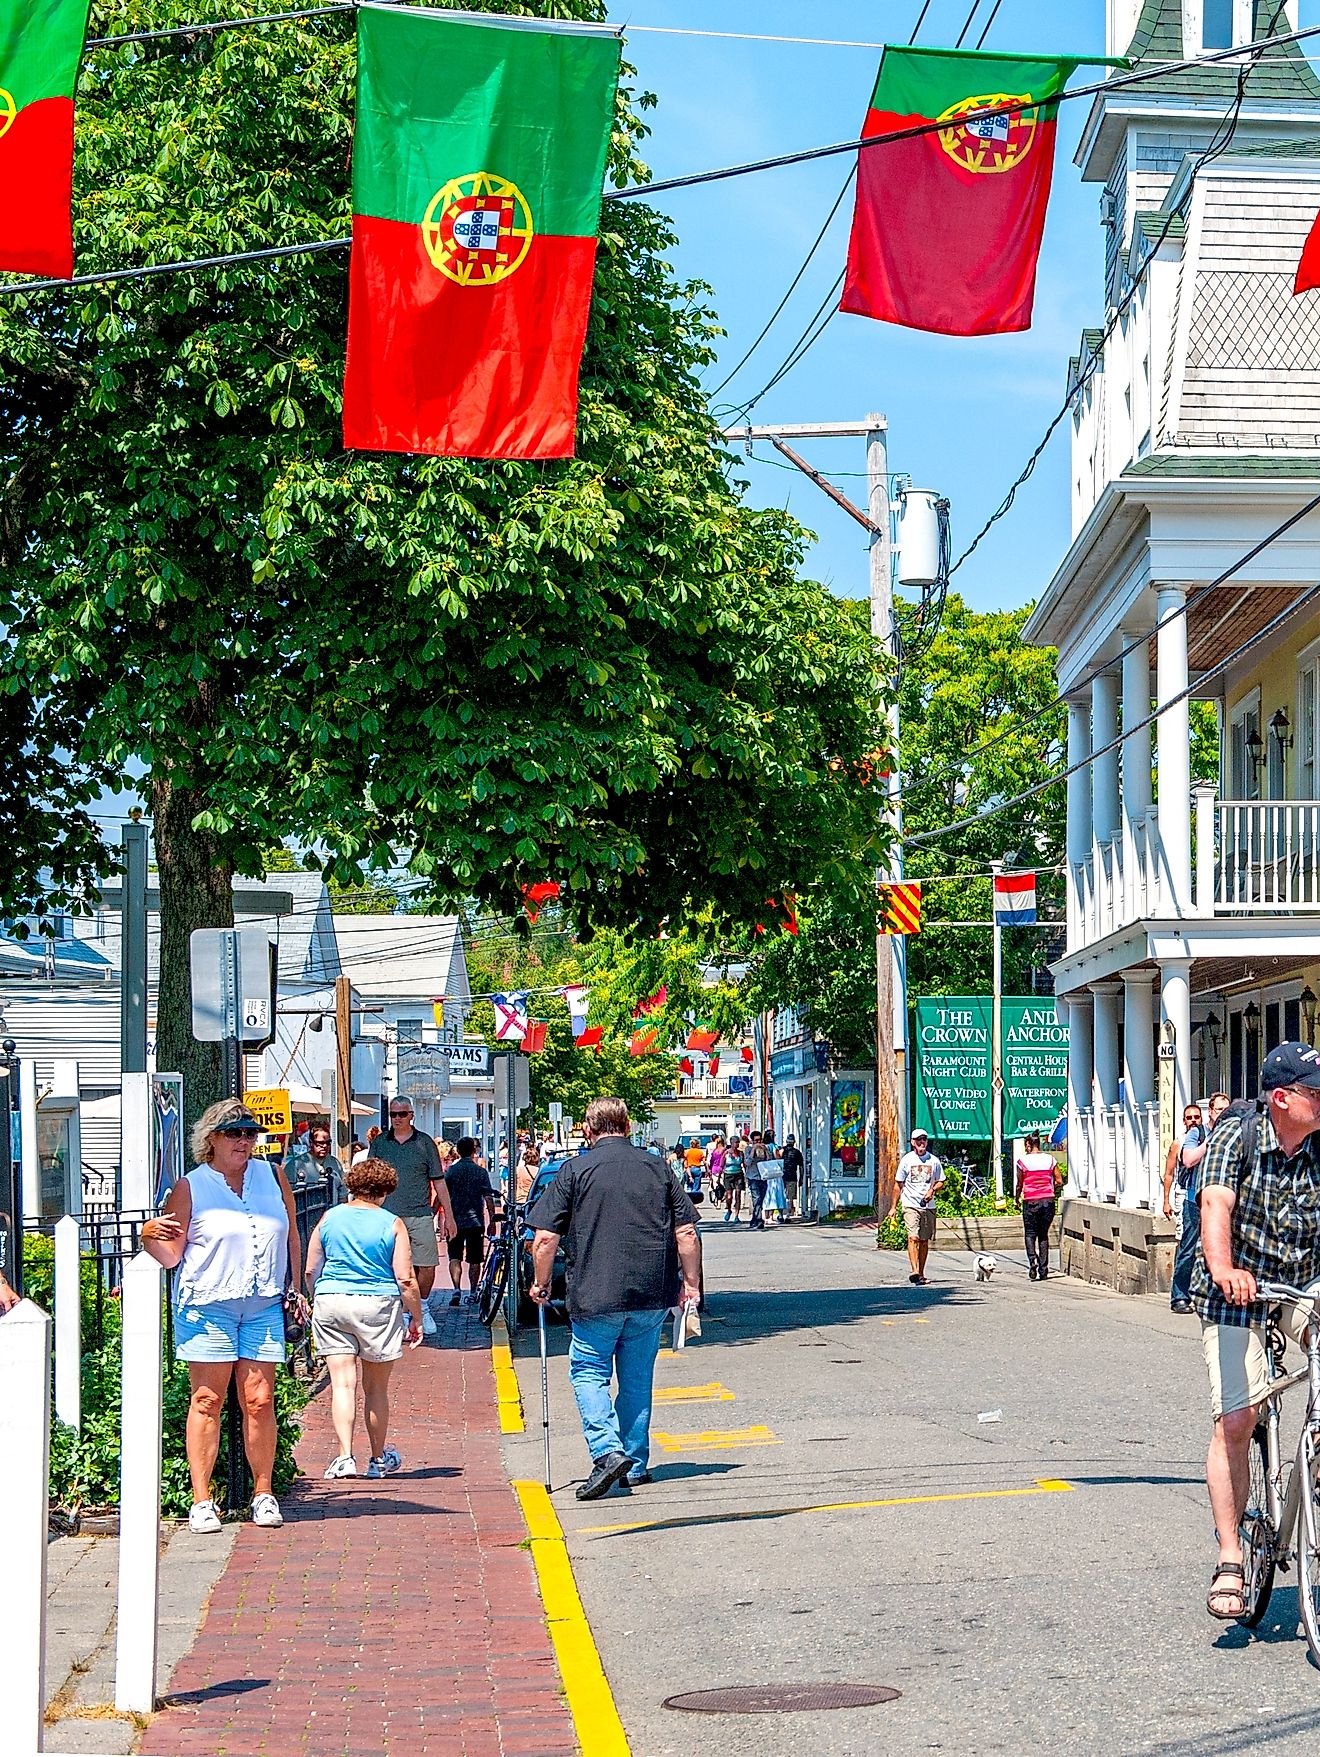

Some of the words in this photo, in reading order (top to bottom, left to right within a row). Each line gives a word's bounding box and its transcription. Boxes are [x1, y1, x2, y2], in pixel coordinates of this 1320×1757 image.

[259, 1000, 267, 1027] RVCA
[937, 1008, 973, 1026] THE
[1020, 1008, 1059, 1026] AND
[921, 1025, 987, 1043] CROWN
[1006, 1026, 1070, 1043] ANCHOR
[443, 1048, 482, 1063] DAMS
[1160, 1046, 1173, 1055] NO
[922, 1055, 987, 1066] PARAMOUNT
[1006, 1055, 1043, 1066] CENTRAL
[922, 1066, 957, 1077] NIGHT
[960, 1066, 987, 1077] CLUB
[1011, 1067, 1028, 1076] BAR
[1030, 1066, 1037, 1076] &
[922, 1087, 951, 1098] WAVE
[954, 1088, 987, 1098] VIDEO
[933, 1099, 976, 1110] LOUNGE
[1026, 1099, 1053, 1109] POOL
[939, 1119, 970, 1130] VAULT
